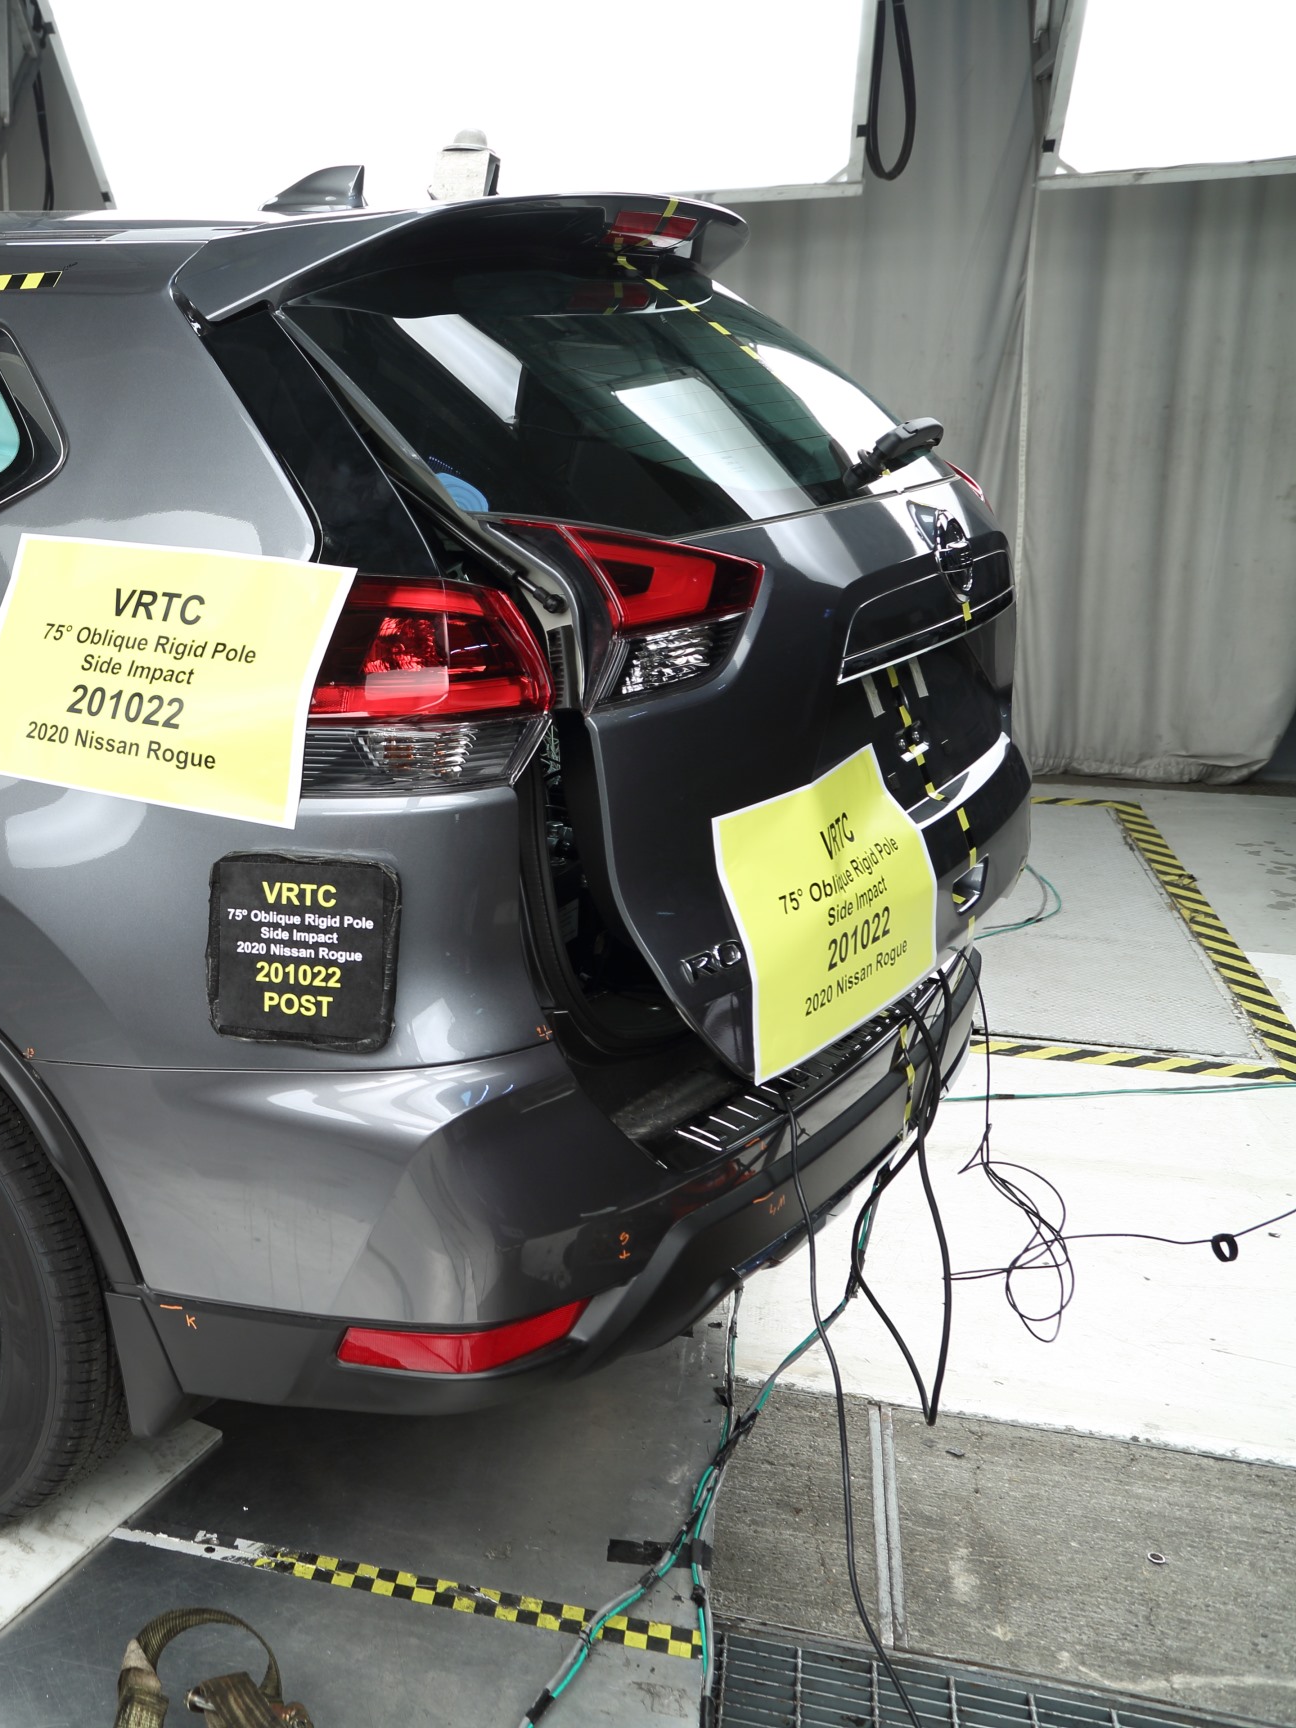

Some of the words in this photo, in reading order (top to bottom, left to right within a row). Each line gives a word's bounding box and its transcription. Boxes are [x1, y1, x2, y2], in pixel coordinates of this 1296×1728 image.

[114, 587, 206, 626] VRTC
[43, 622, 73, 641] 75°
[76, 626, 148, 653] Oblique
[154, 635, 208, 661] Rigid
[211, 642, 256, 664] Pole
[81, 654, 122, 675] Side
[127, 660, 195, 685] Impact
[66, 684, 184, 730] 201022
[26, 721, 69, 744] 2020
[74, 728, 140, 757] Nissan
[147, 740, 216, 770] Rogue
[819, 812, 855, 860] VRTC
[261, 881, 337, 907] VRTC
[778, 888, 803, 915] 75°
[809, 868, 854, 902] Oblique
[850, 848, 880, 877] Rigid
[874, 836, 899, 860] Pole
[250, 910, 301, 926] Oblique
[304, 914, 340, 929] Rigid
[343, 916, 374, 929] Pole
[828, 900, 854, 926] Side
[856, 875, 888, 911] Impact
[236, 941, 267, 955] 2020
[270, 944, 315, 958] Nissan
[318, 947, 363, 963] Rogue
[260, 926, 290, 940] Side
[293, 929, 338, 944] Impact
[827, 906, 891, 972] 201022
[255, 961, 341, 988] 201022
[805, 985, 833, 1017] 2020
[836, 963, 873, 998] Nissan
[876, 940, 908, 971] Rogue
[263, 991, 334, 1017] POST
[185, 1313, 198, 1330] K
